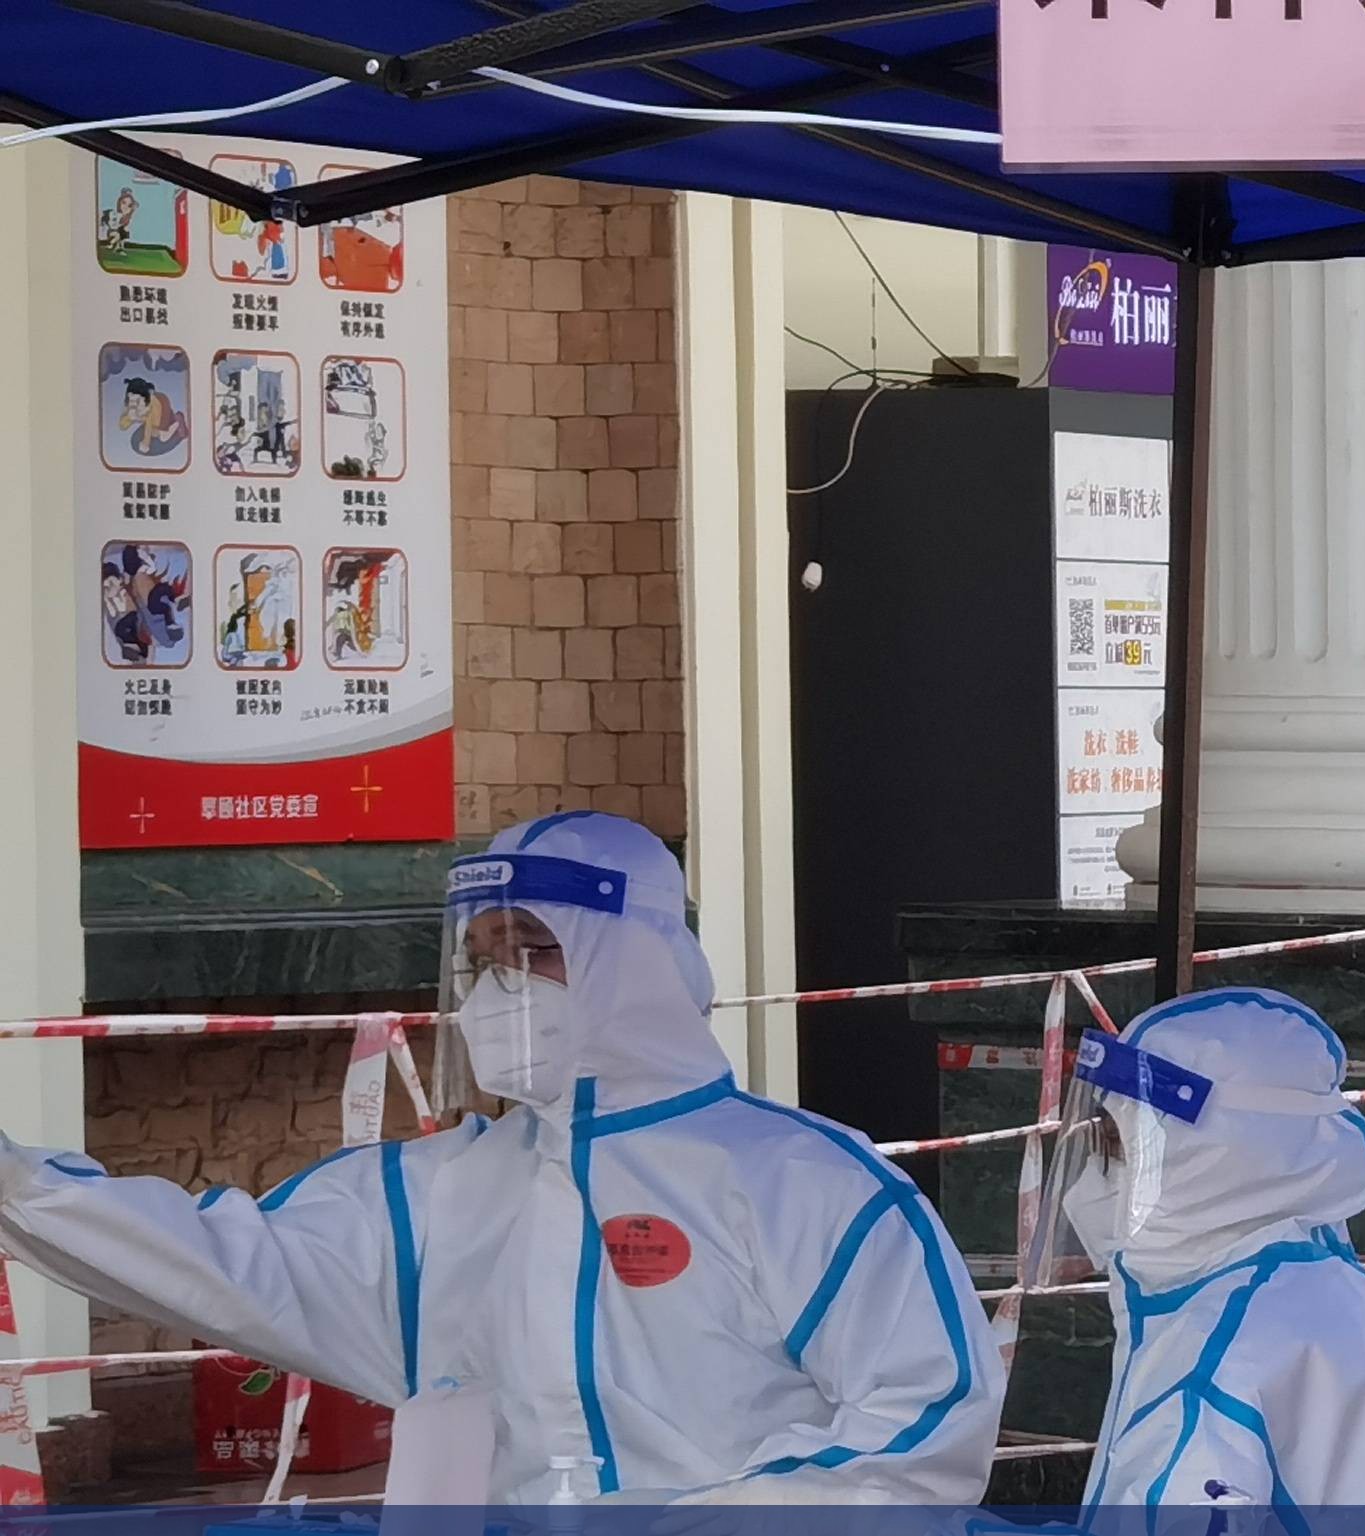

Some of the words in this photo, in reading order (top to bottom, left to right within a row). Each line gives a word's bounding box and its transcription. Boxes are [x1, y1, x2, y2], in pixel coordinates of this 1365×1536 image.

[1110, 276, 1177, 346] 柏丽
[1088, 484, 1162, 519] 柏丽斯洗衣
[201, 794, 319, 820] 翠颐社区党委宣
